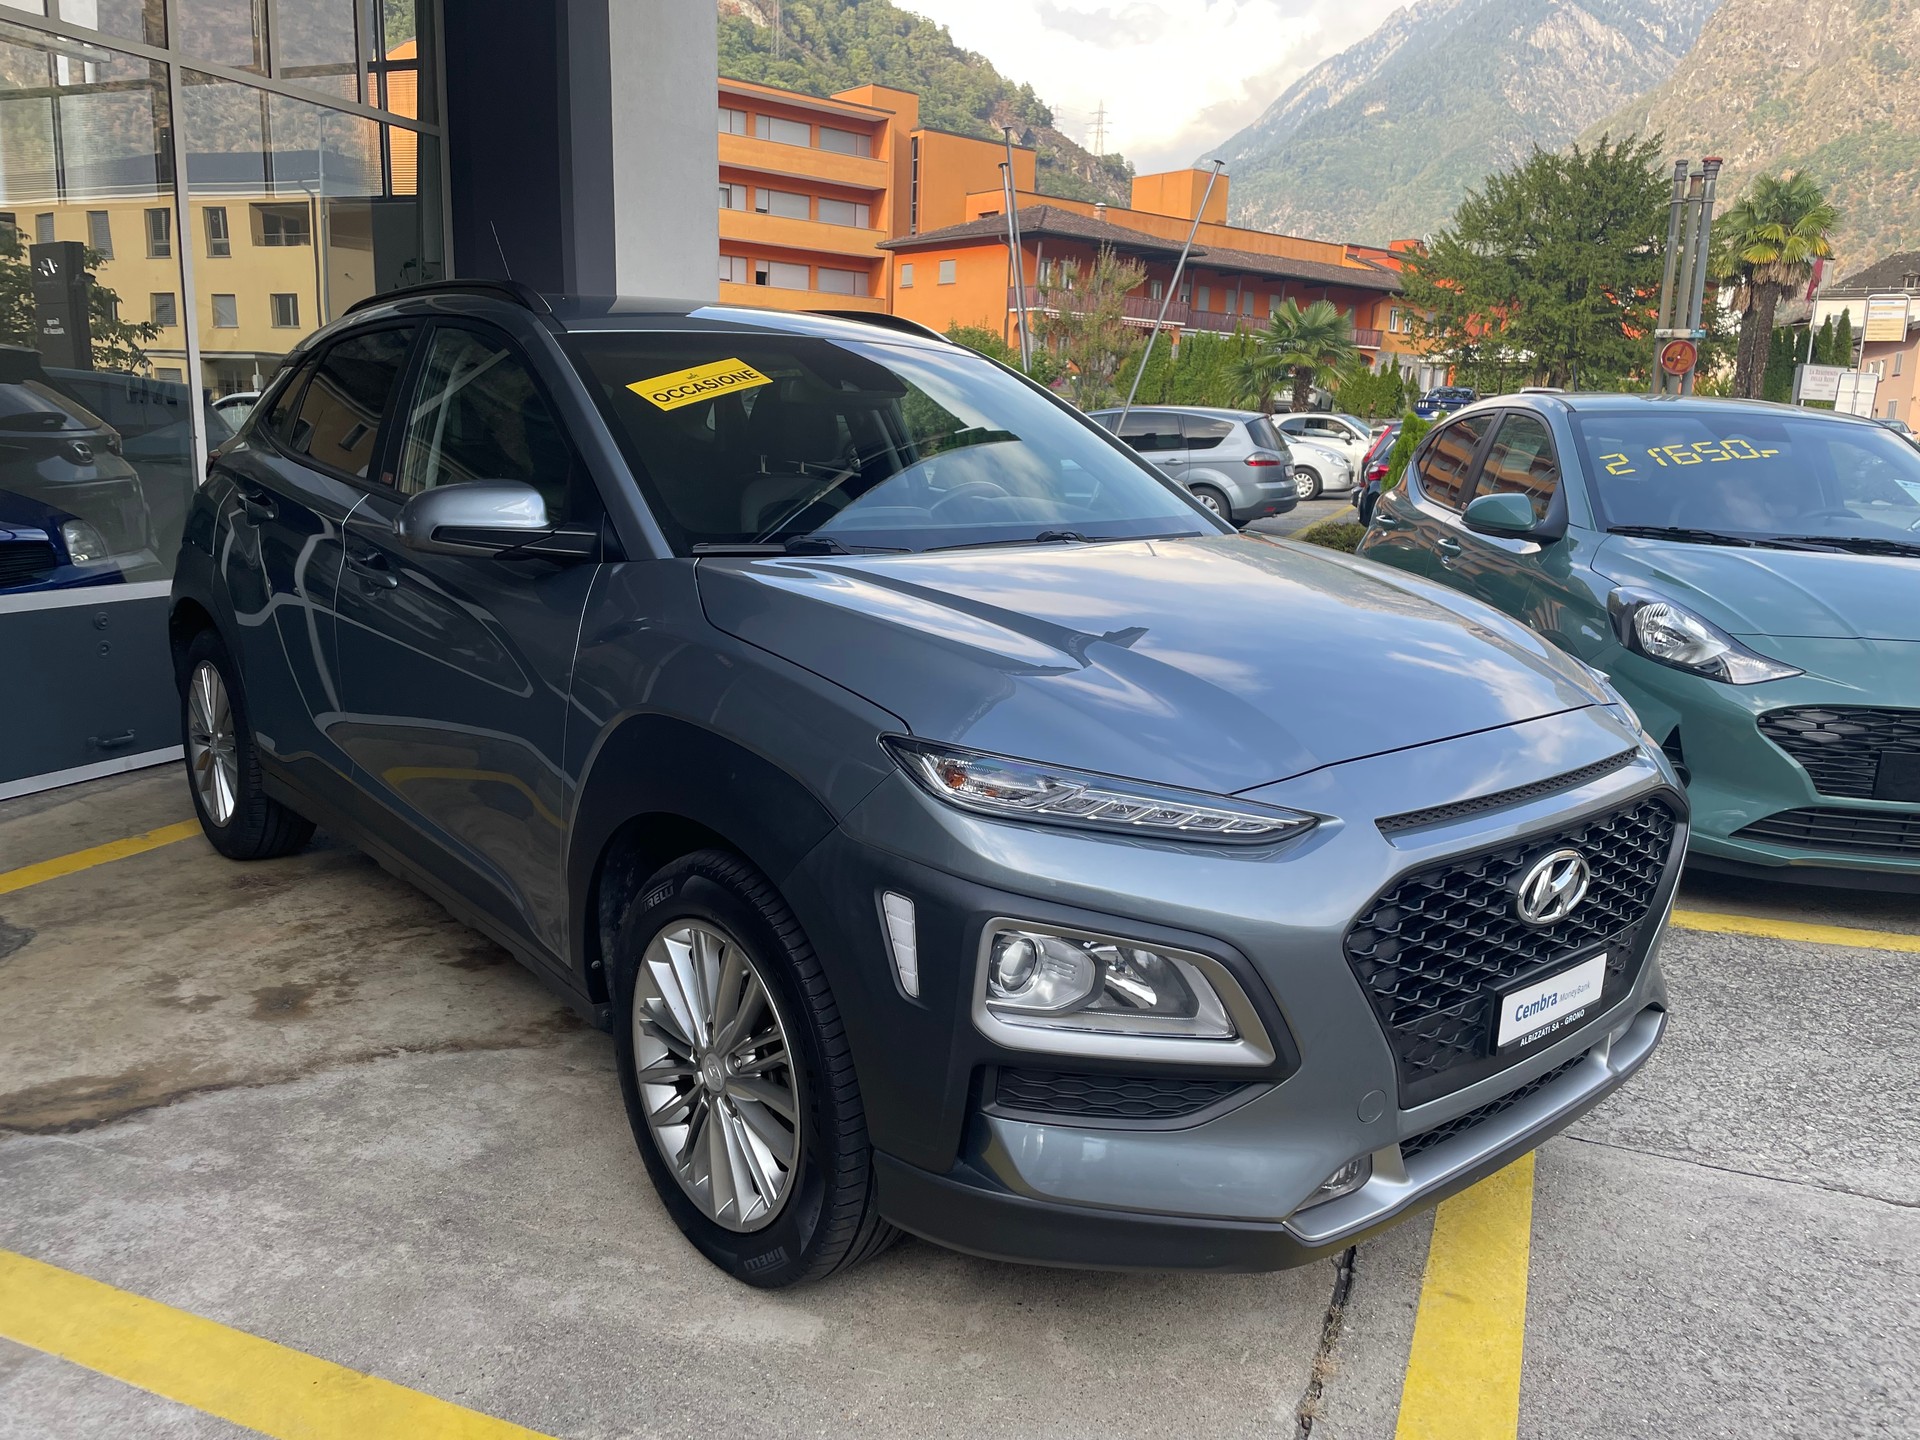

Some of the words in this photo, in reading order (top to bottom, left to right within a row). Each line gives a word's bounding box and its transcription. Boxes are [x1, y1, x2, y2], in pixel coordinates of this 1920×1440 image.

[652, 370, 760, 402] OCCASIONE
[1515, 992, 1558, 1022] Cembra
[1559, 980, 1590, 1002] MoneyBank
[1520, 1026, 1551, 1047] ALBIZZATI
[1551, 1021, 1560, 1032] SA
[1564, 1009, 1585, 1025] GRONO
